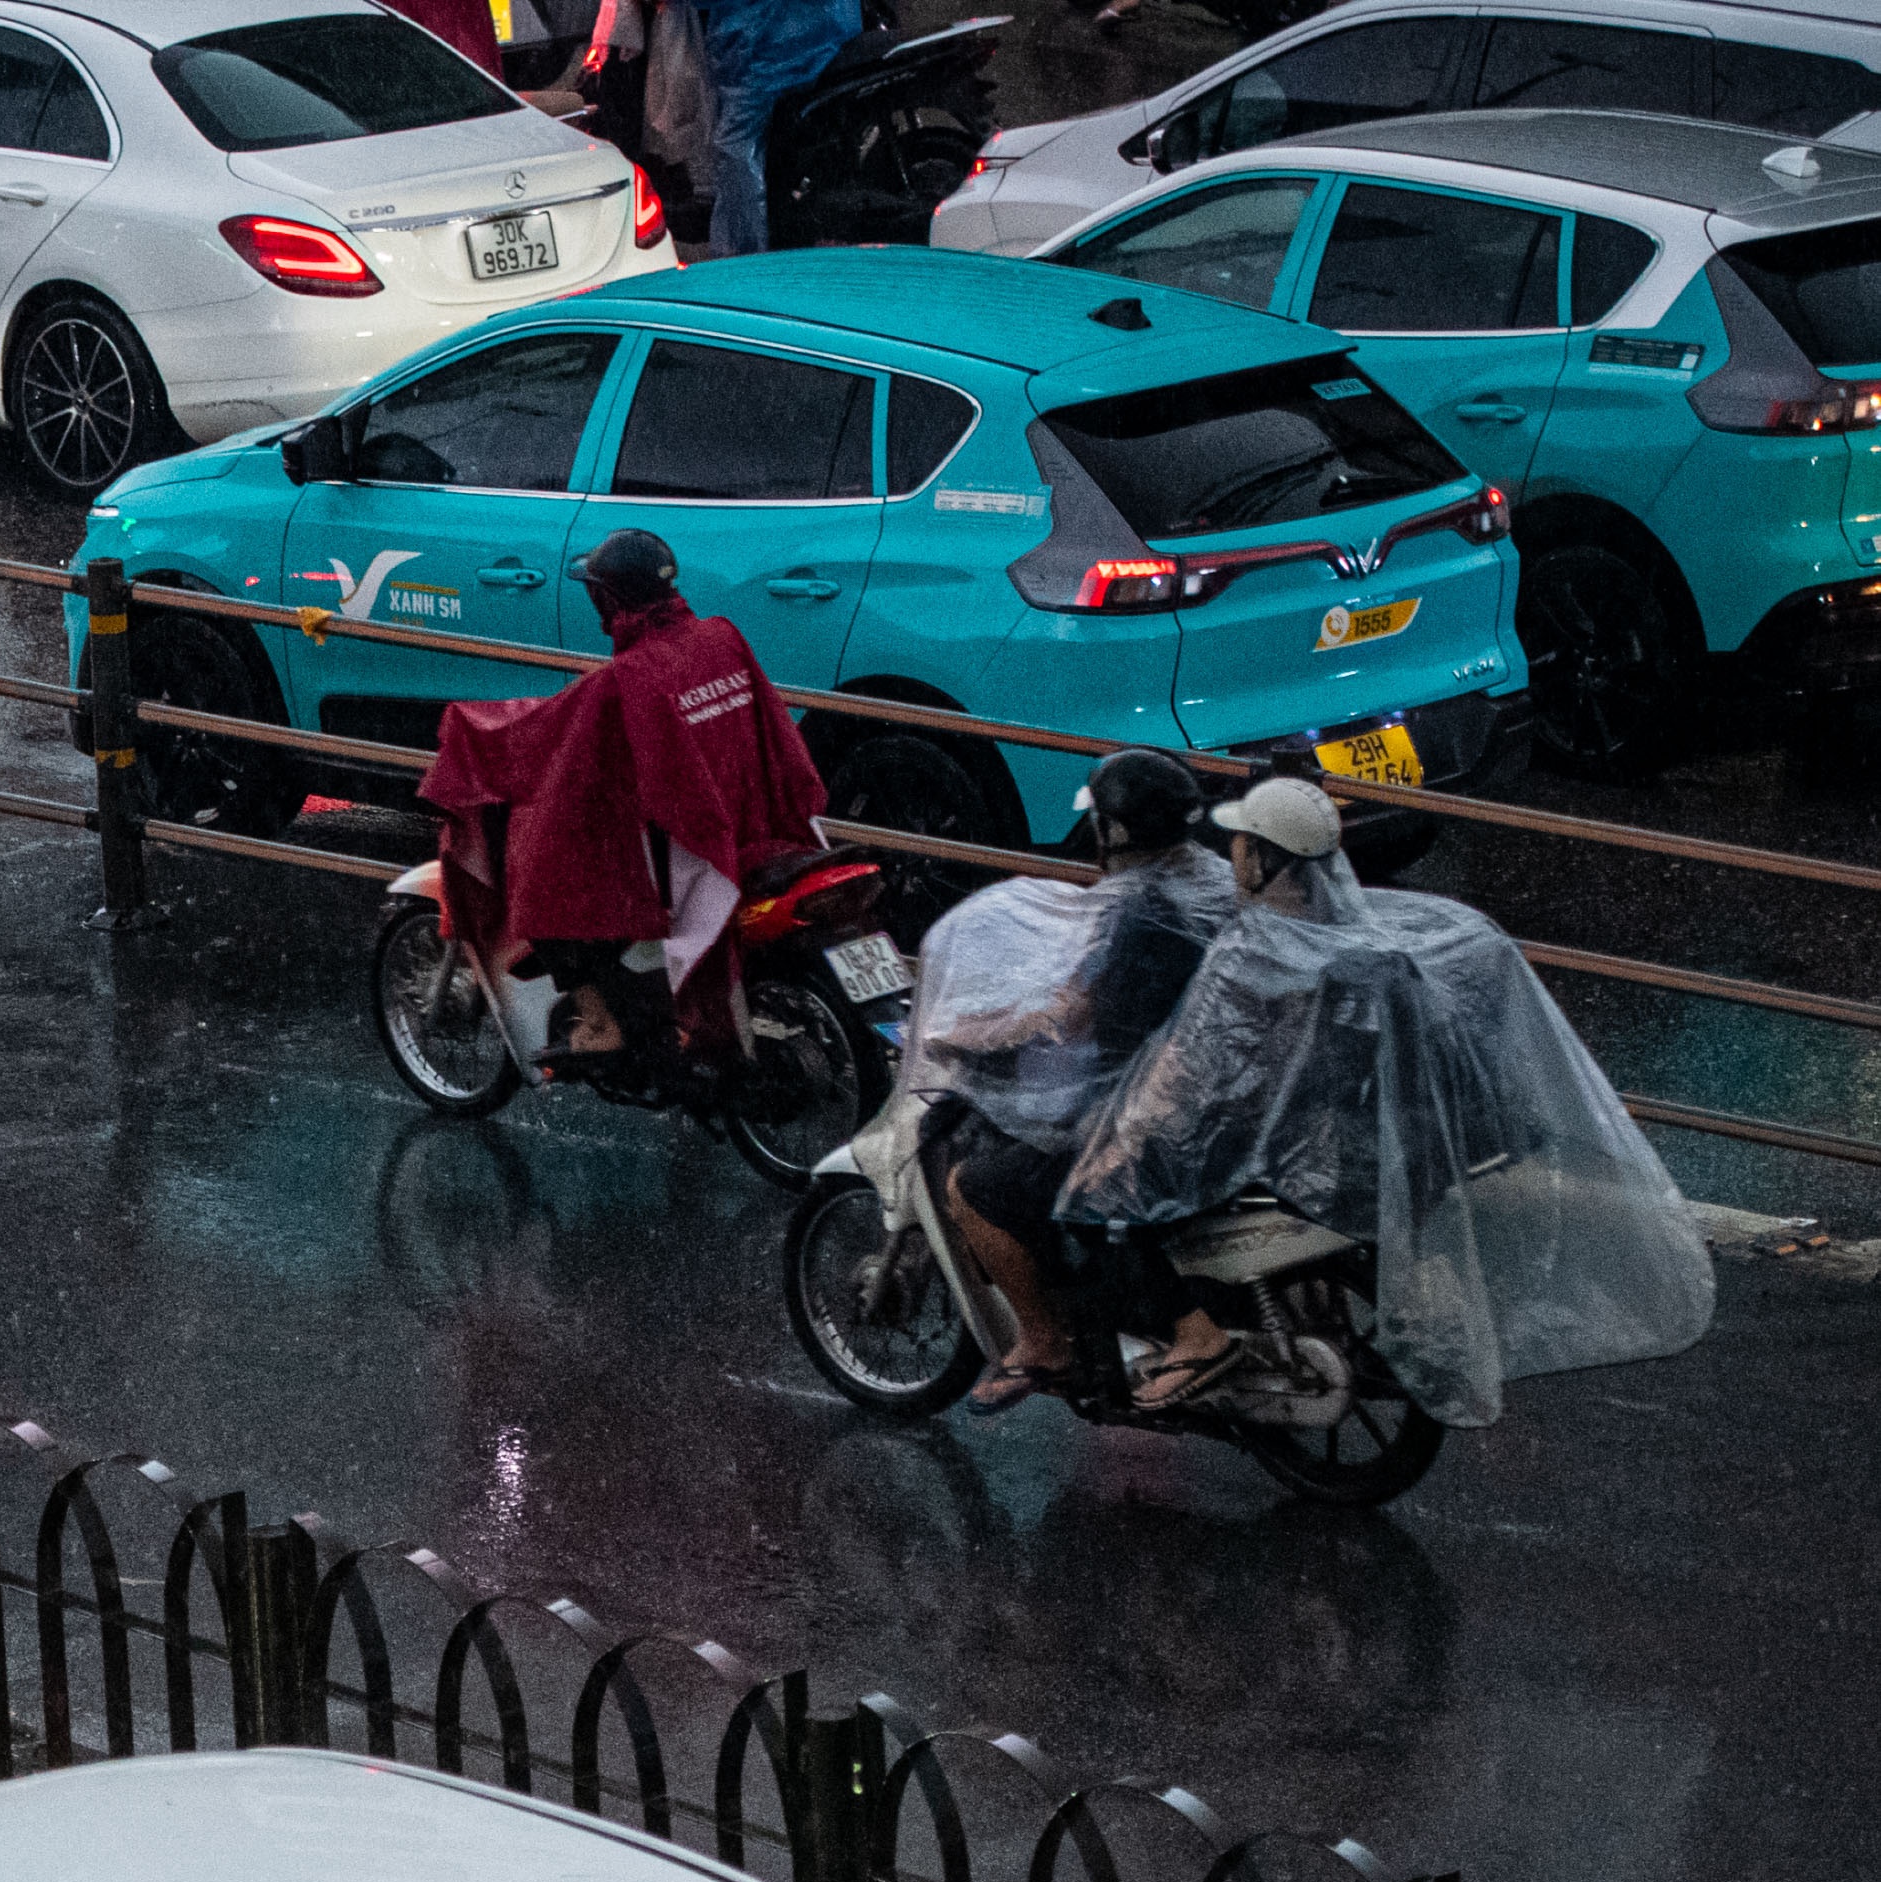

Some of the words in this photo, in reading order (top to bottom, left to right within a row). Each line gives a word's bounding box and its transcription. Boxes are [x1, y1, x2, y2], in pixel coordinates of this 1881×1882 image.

[492, 219, 529, 246] 30K
[483, 242, 548, 274] 969.72
[389, 589, 435, 616] XANH
[438, 596, 462, 619] SM
[1354, 610, 1393, 637] 1555
[1343, 733, 1390, 767] 29H
